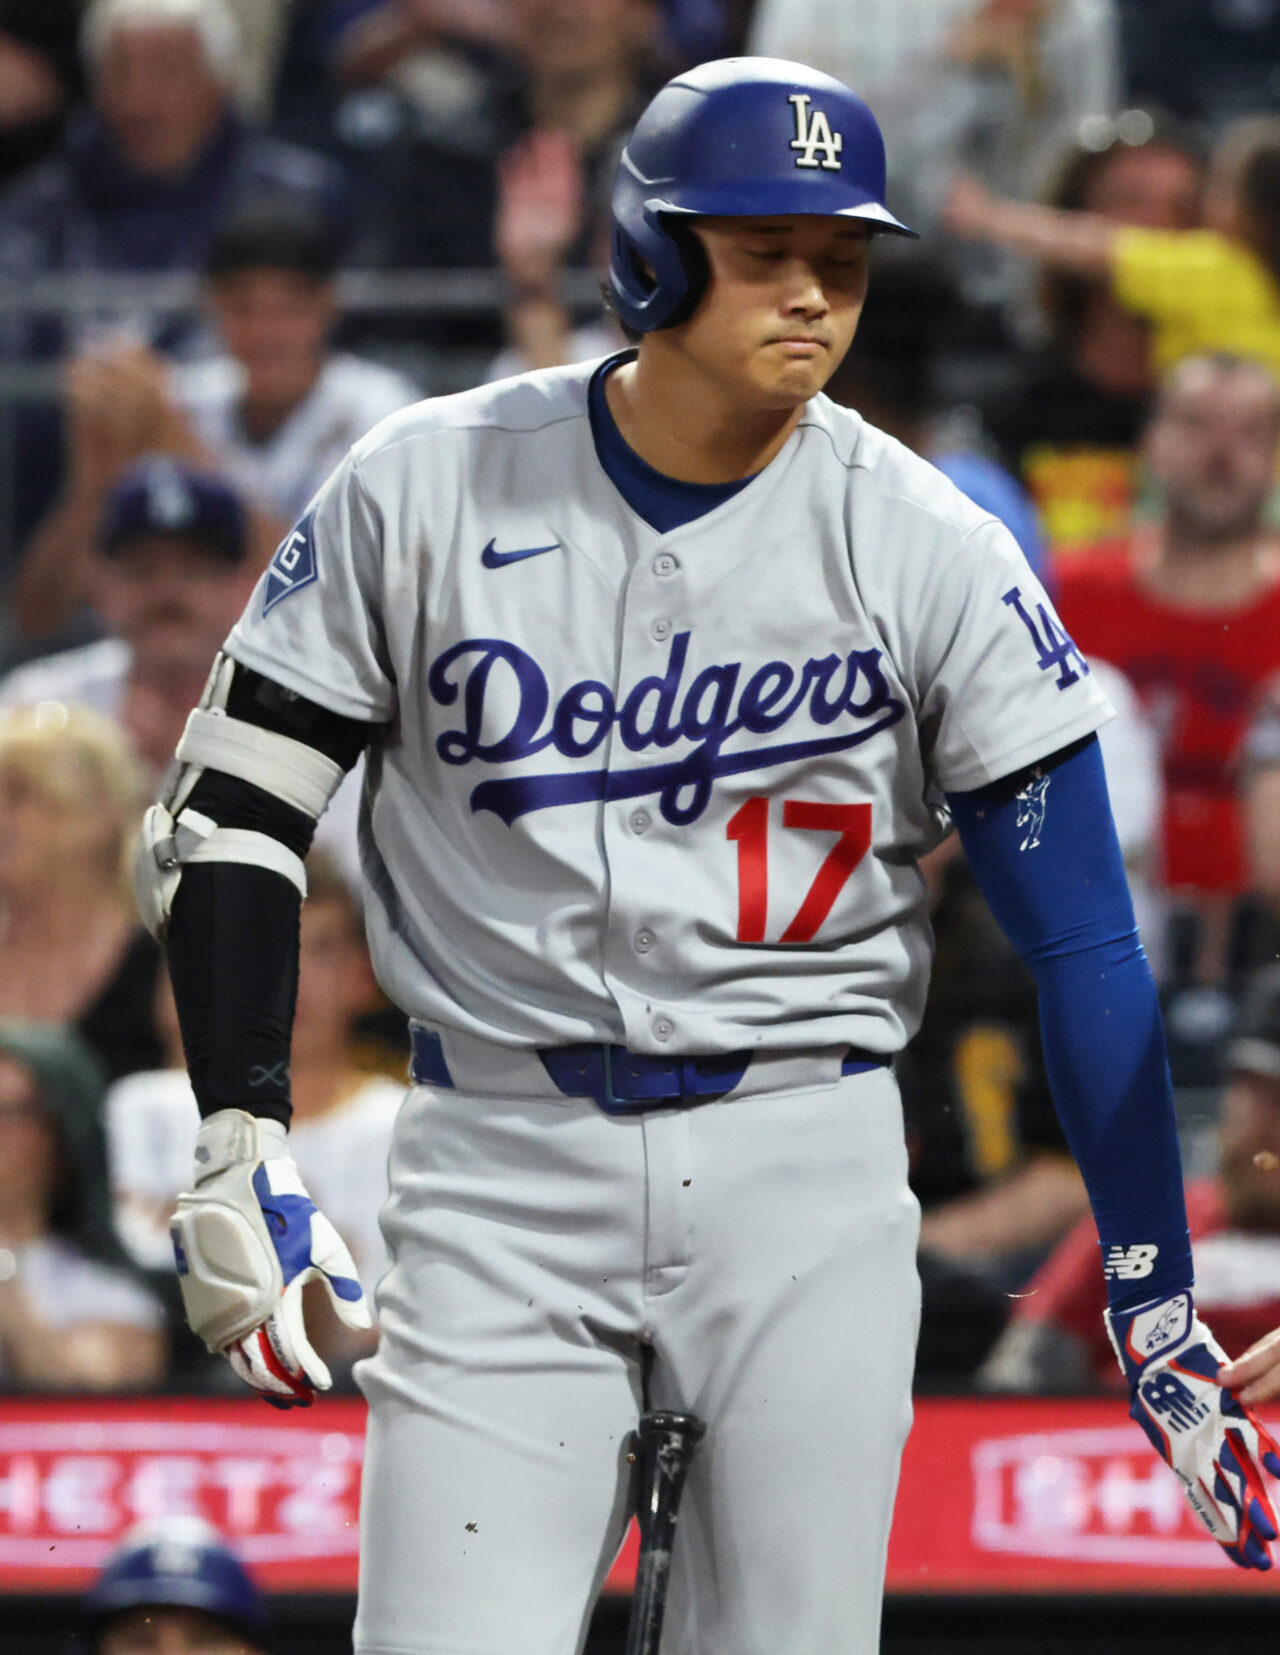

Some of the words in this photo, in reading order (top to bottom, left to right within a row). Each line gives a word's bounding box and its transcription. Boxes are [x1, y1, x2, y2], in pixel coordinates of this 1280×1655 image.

[788, 94, 843, 169] LA
[279, 530, 307, 571] G
[1000, 586, 1090, 692] LA
[428, 630, 906, 828] Dodgers
[726, 796, 873, 944] 17
